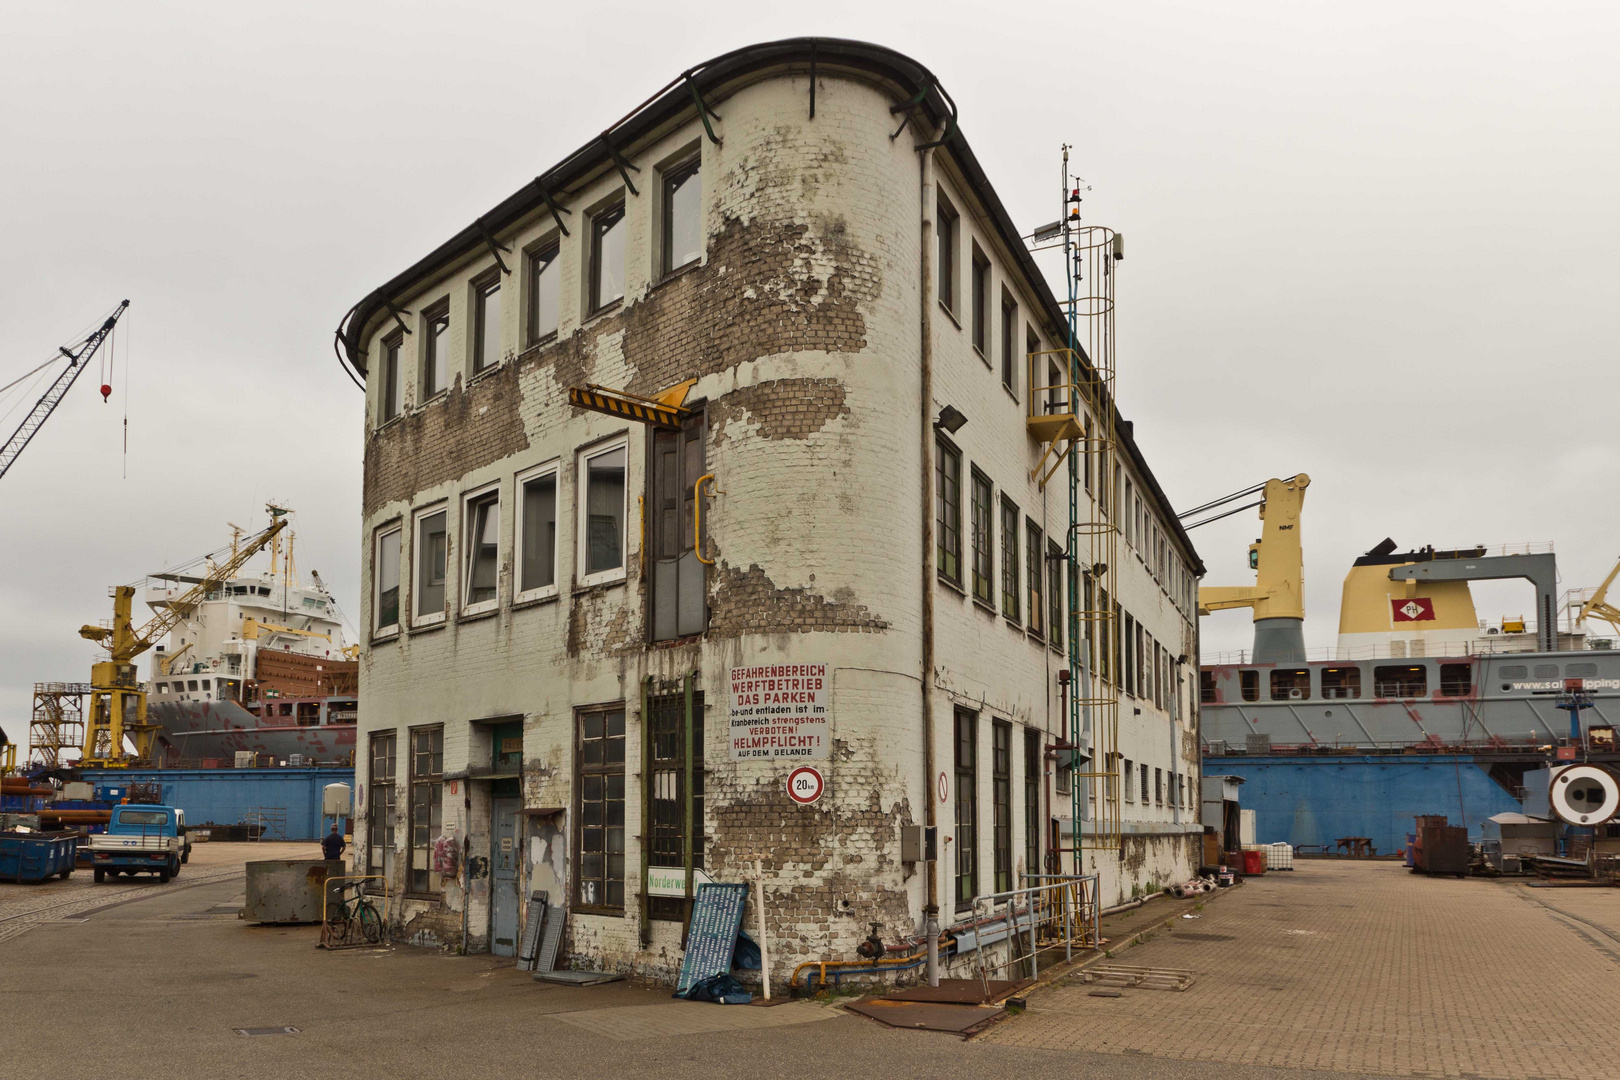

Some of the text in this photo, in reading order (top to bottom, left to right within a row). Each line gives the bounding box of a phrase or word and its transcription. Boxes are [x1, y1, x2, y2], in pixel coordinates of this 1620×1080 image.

[1406, 605, 1418, 614] PH
[731, 665, 825, 681] GEFAHRENBEREICH
[732, 678, 823, 693] WERFTBETRIEB
[738, 691, 816, 706] DAS PARKEN
[755, 706, 791, 715] entladen
[795, 705, 808, 714] ist
[813, 705, 825, 713] im
[772, 716, 826, 726] strengstens
[749, 726, 798, 735] VERBOTEN!
[752, 749, 769, 757] DEM
[649, 874, 698, 891] Norderwet
